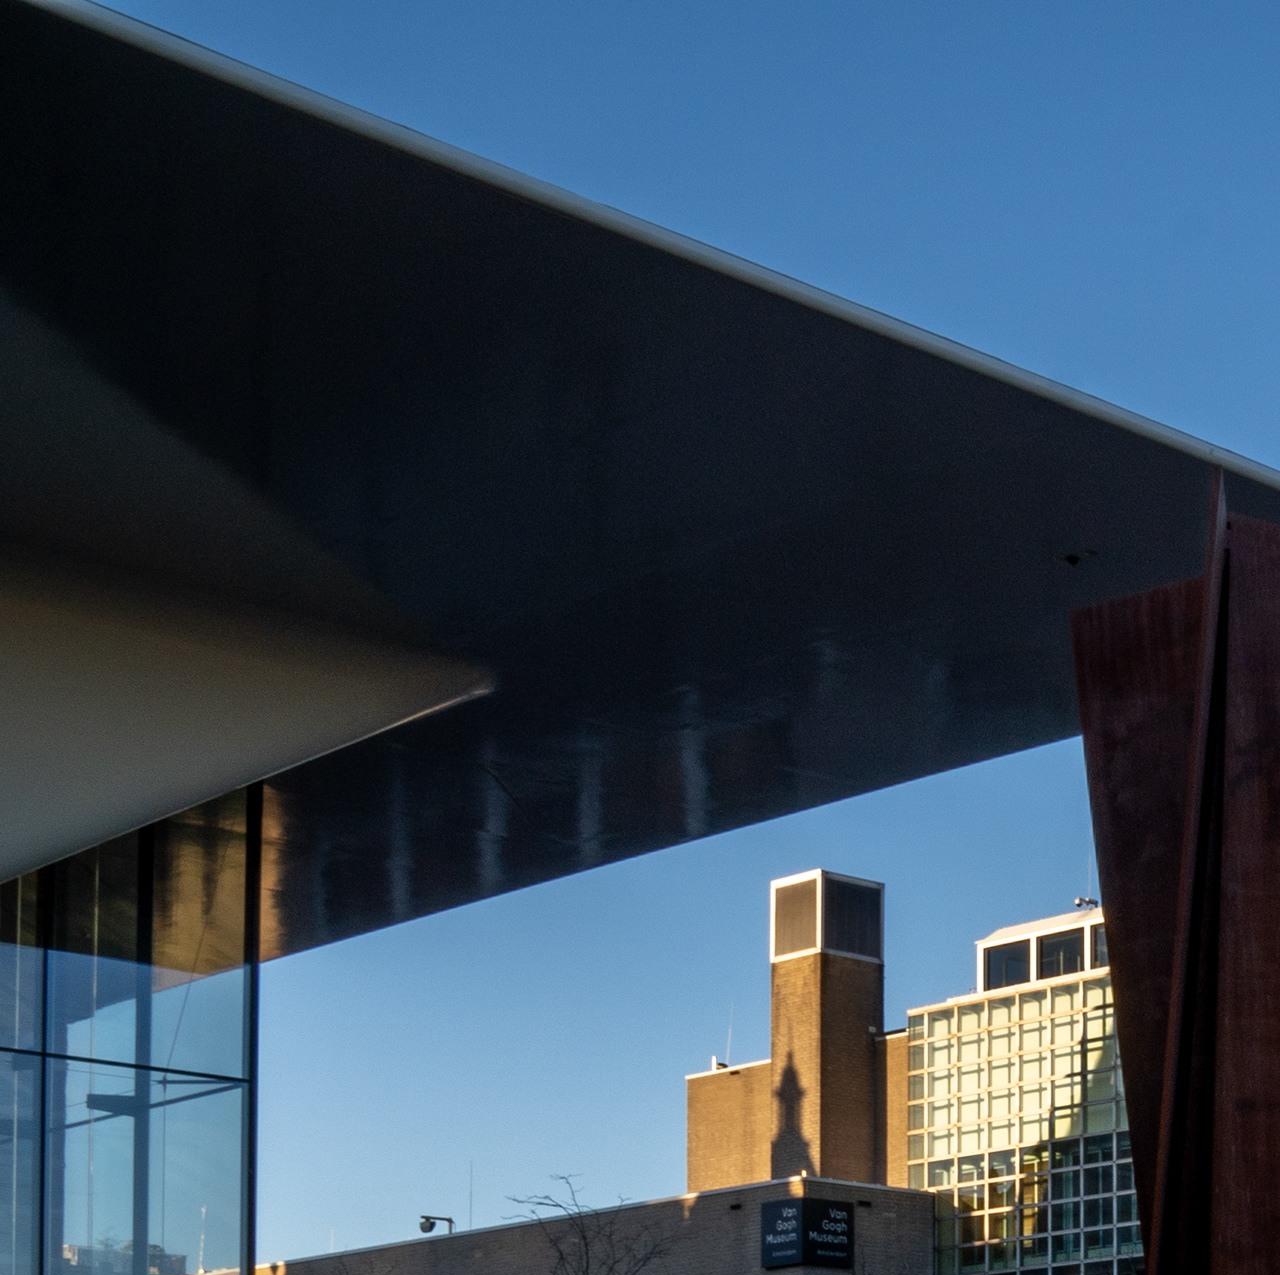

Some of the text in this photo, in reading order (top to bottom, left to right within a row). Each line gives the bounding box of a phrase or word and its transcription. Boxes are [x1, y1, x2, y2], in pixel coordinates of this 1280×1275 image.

[782, 1207, 797, 1217] Van
[829, 1208, 847, 1219] Van
[776, 1219, 797, 1231] Gogh
[822, 1219, 847, 1233] Gogh
[808, 1231, 847, 1244] Museum
